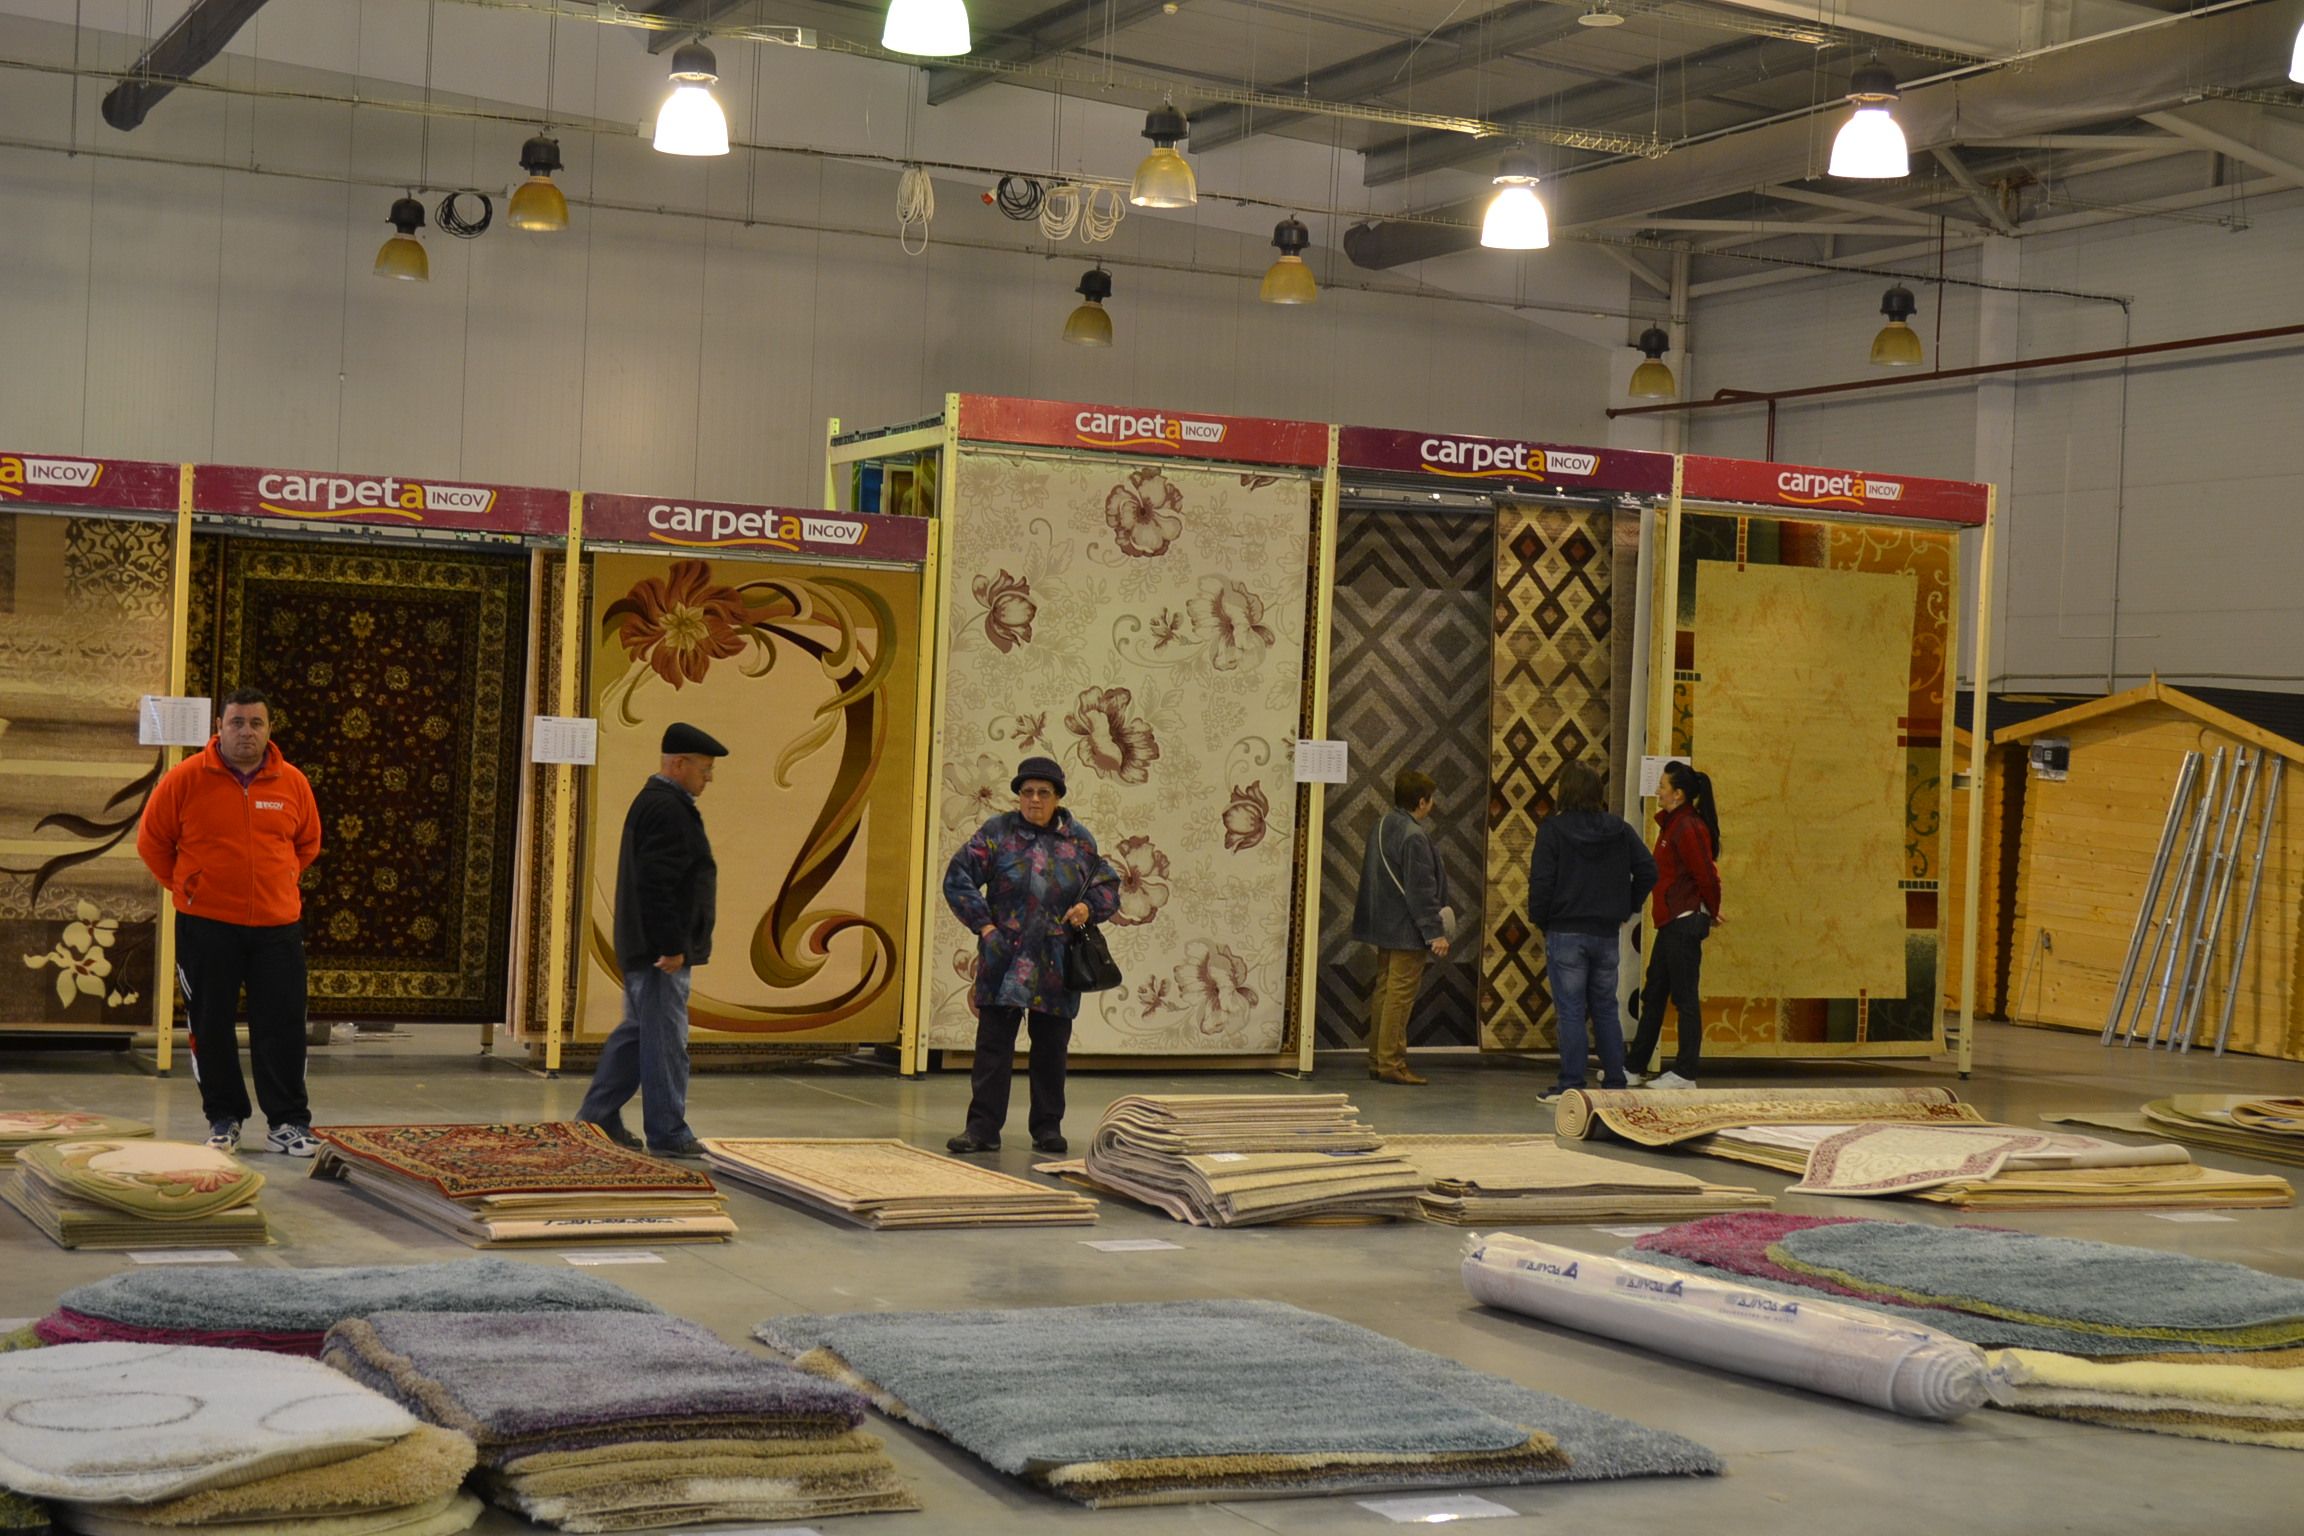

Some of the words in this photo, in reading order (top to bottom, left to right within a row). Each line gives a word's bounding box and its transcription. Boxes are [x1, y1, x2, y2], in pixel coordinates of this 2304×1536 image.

[1075, 412, 1181, 440] carpeta
[1185, 426, 1220, 438] INCOV
[1420, 439, 1546, 471] carpeta
[1551, 457, 1591, 470] INCOV
[32, 465, 90, 481] INCOV
[1778, 472, 1865, 498] carpeta
[1868, 485, 1897, 496] INCOV
[258, 474, 424, 509] carpeta
[432, 491, 485, 507] INCOV
[648, 505, 801, 540] carpeta
[808, 524, 858, 539] INCOV
